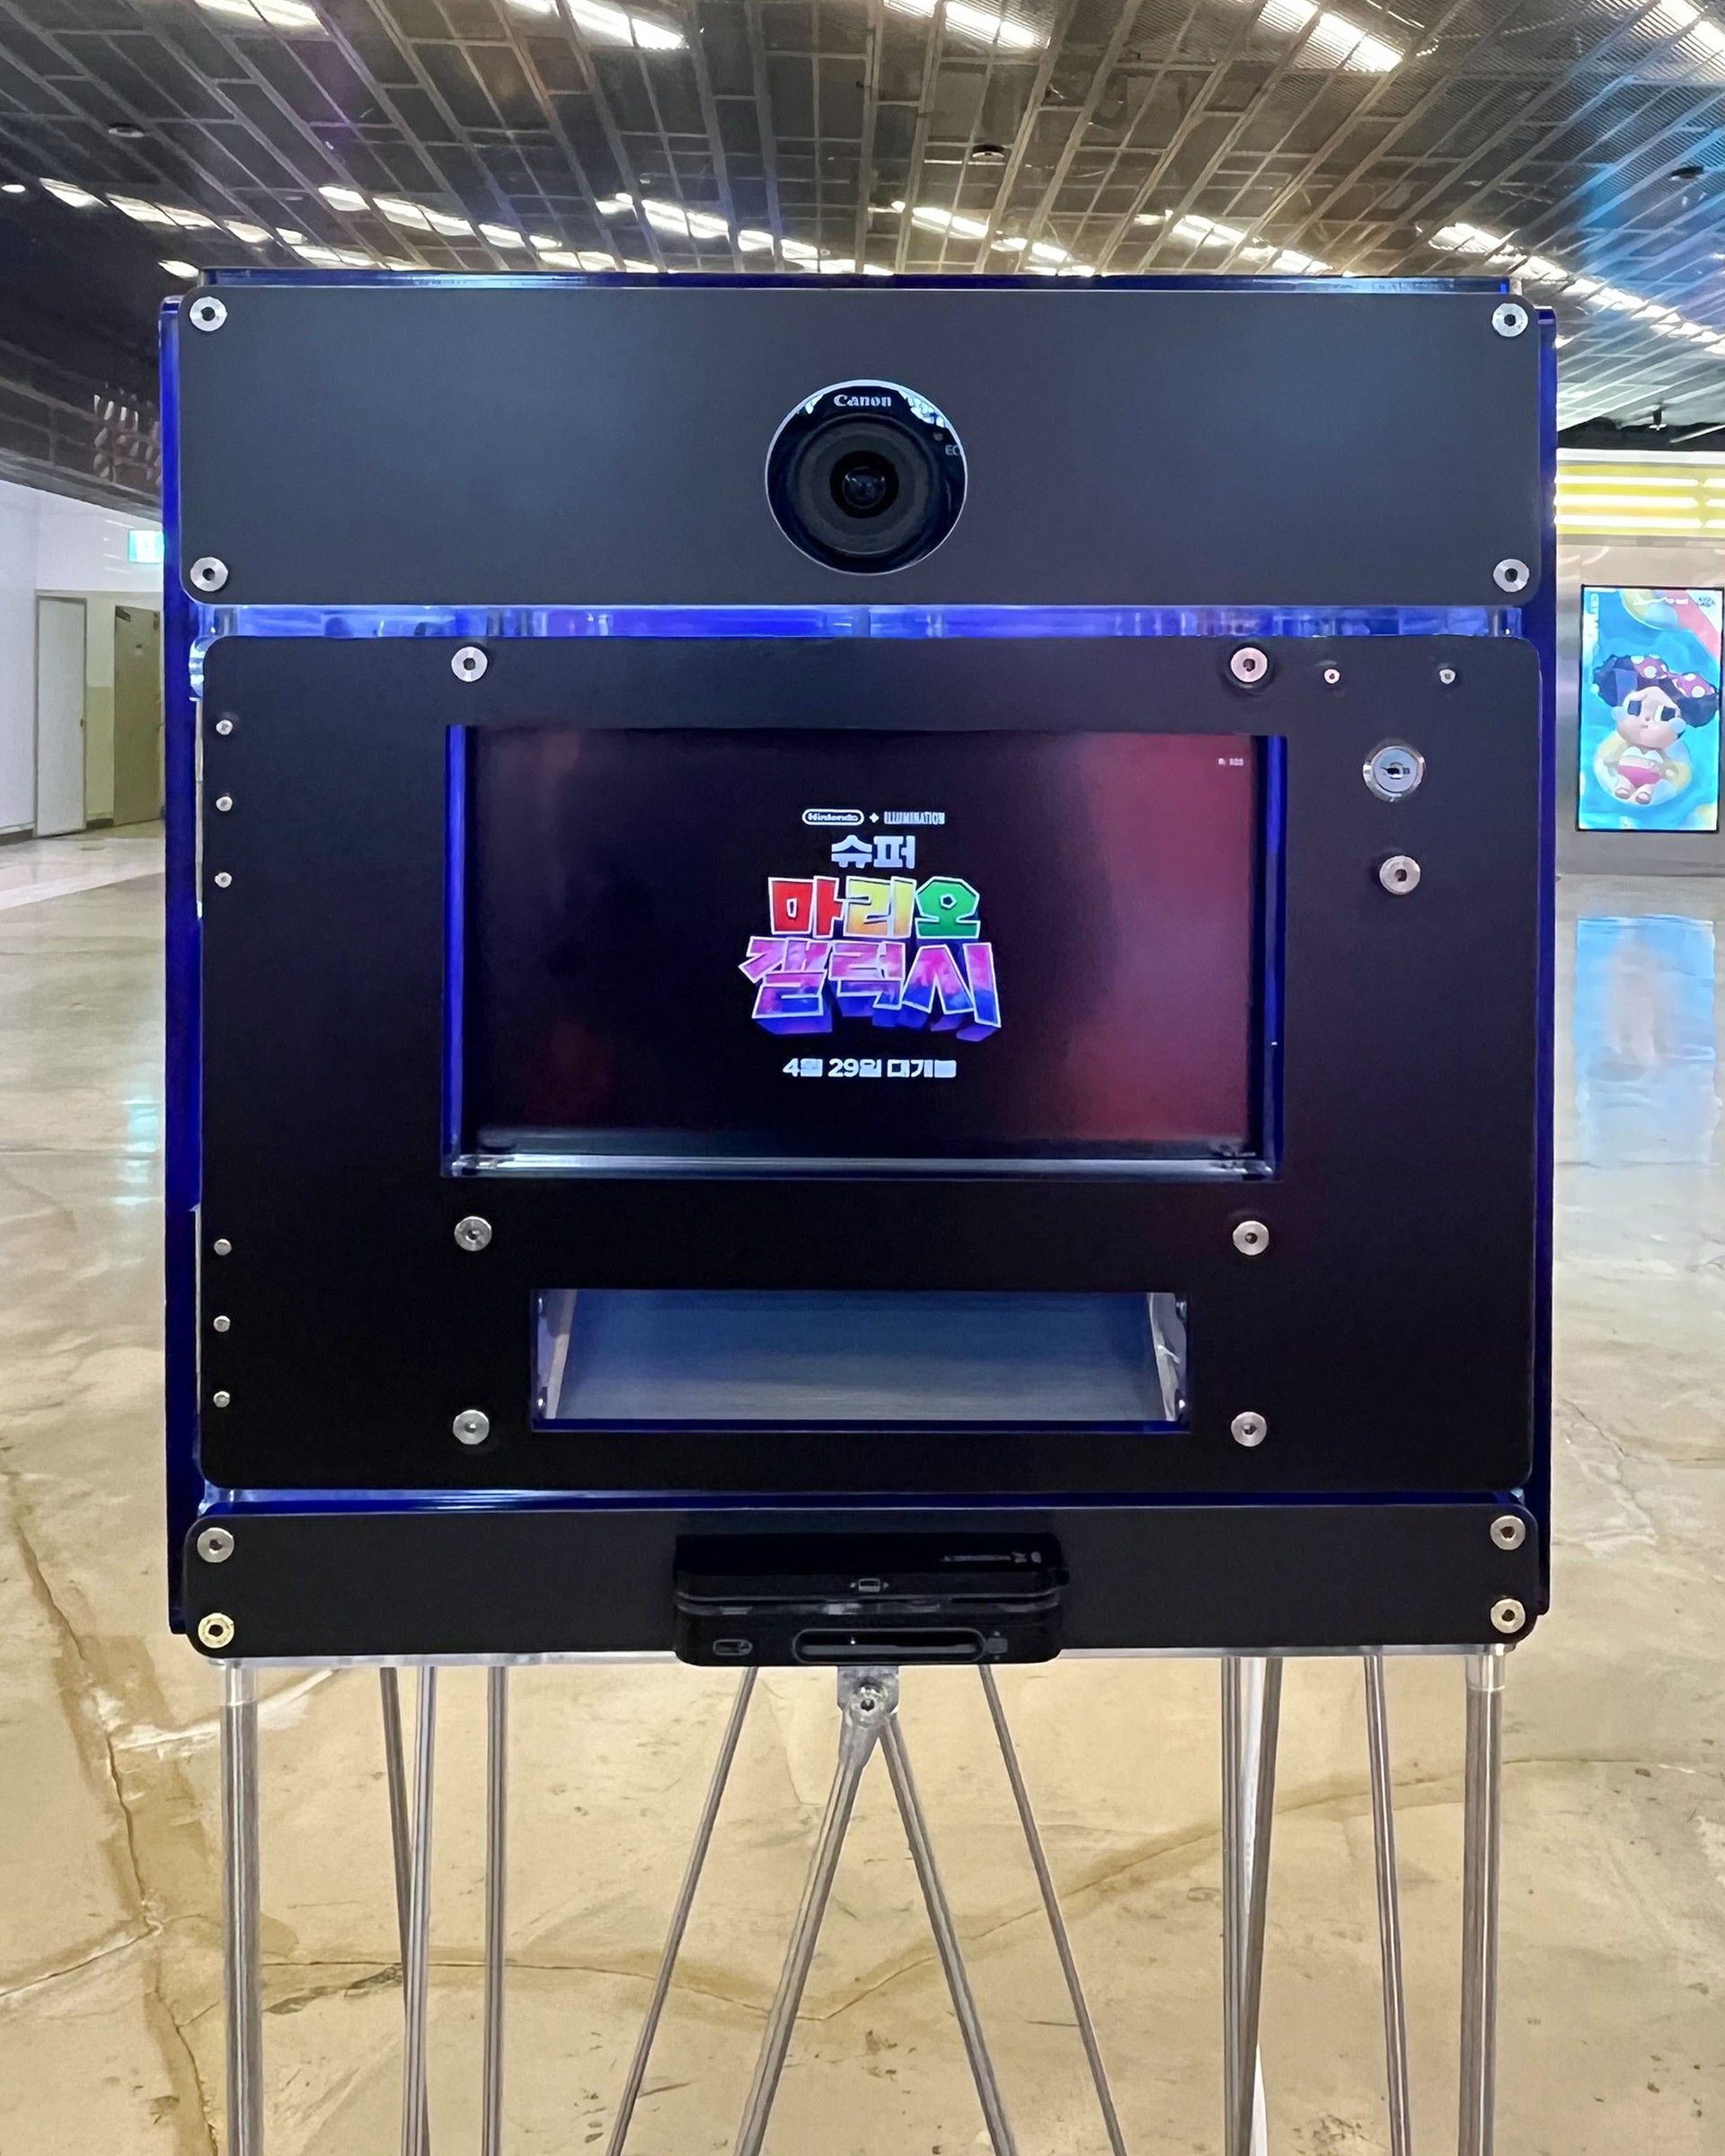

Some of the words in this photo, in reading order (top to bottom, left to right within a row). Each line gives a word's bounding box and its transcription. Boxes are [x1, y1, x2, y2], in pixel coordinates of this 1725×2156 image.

[833, 394, 891, 407] Canon
[806, 812, 860, 822] Nintendo
[884, 811, 945, 825] ILLUMINATION
[831, 835, 916, 869] 슈퍼
[768, 875, 980, 939] 마리오
[738, 936, 1002, 1030] 갤럭시
[827, 1058, 881, 1078] 29일
